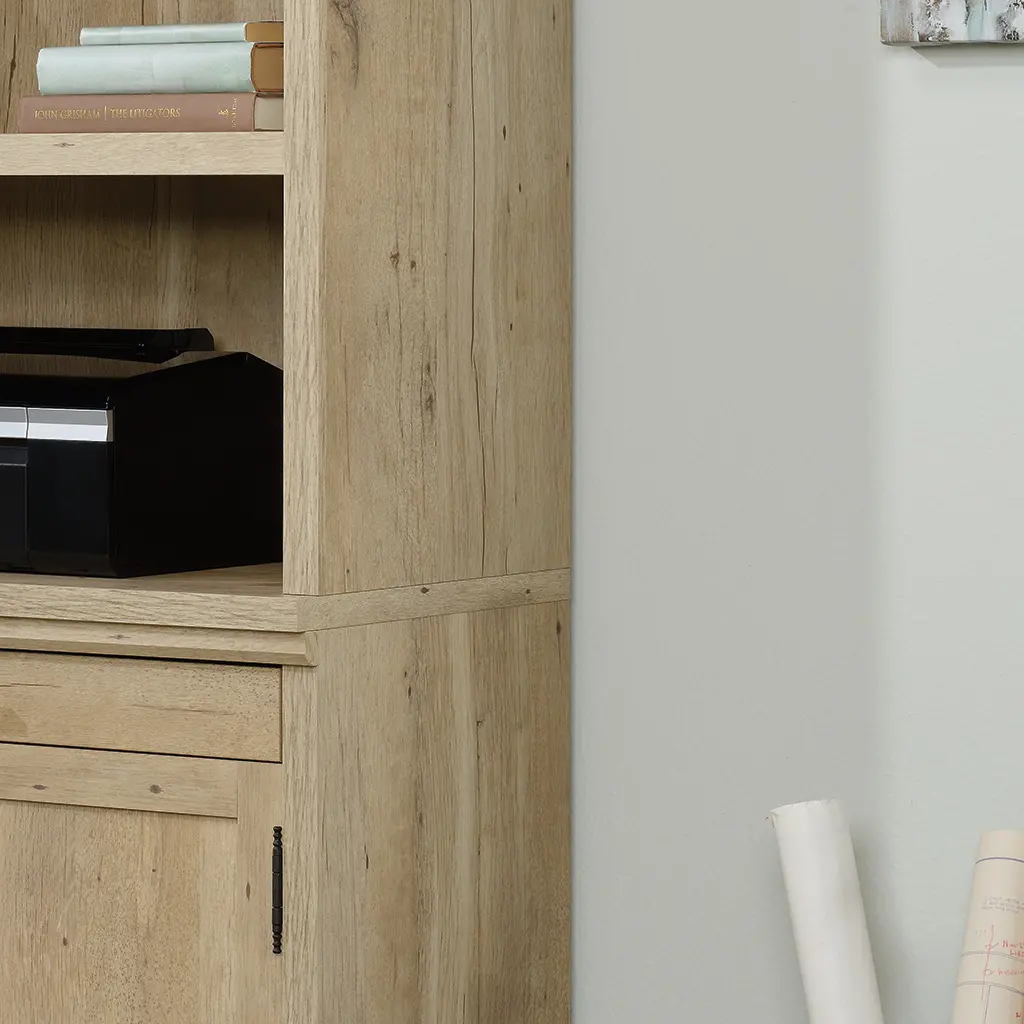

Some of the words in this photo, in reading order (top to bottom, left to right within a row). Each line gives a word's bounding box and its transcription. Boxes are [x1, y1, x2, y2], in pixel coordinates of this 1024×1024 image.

[34, 109, 58, 120] JOHN
[60, 109, 101, 120] GRISHAM
[110, 108, 127, 119] THE
[129, 107, 181, 119] LITIGATORS
